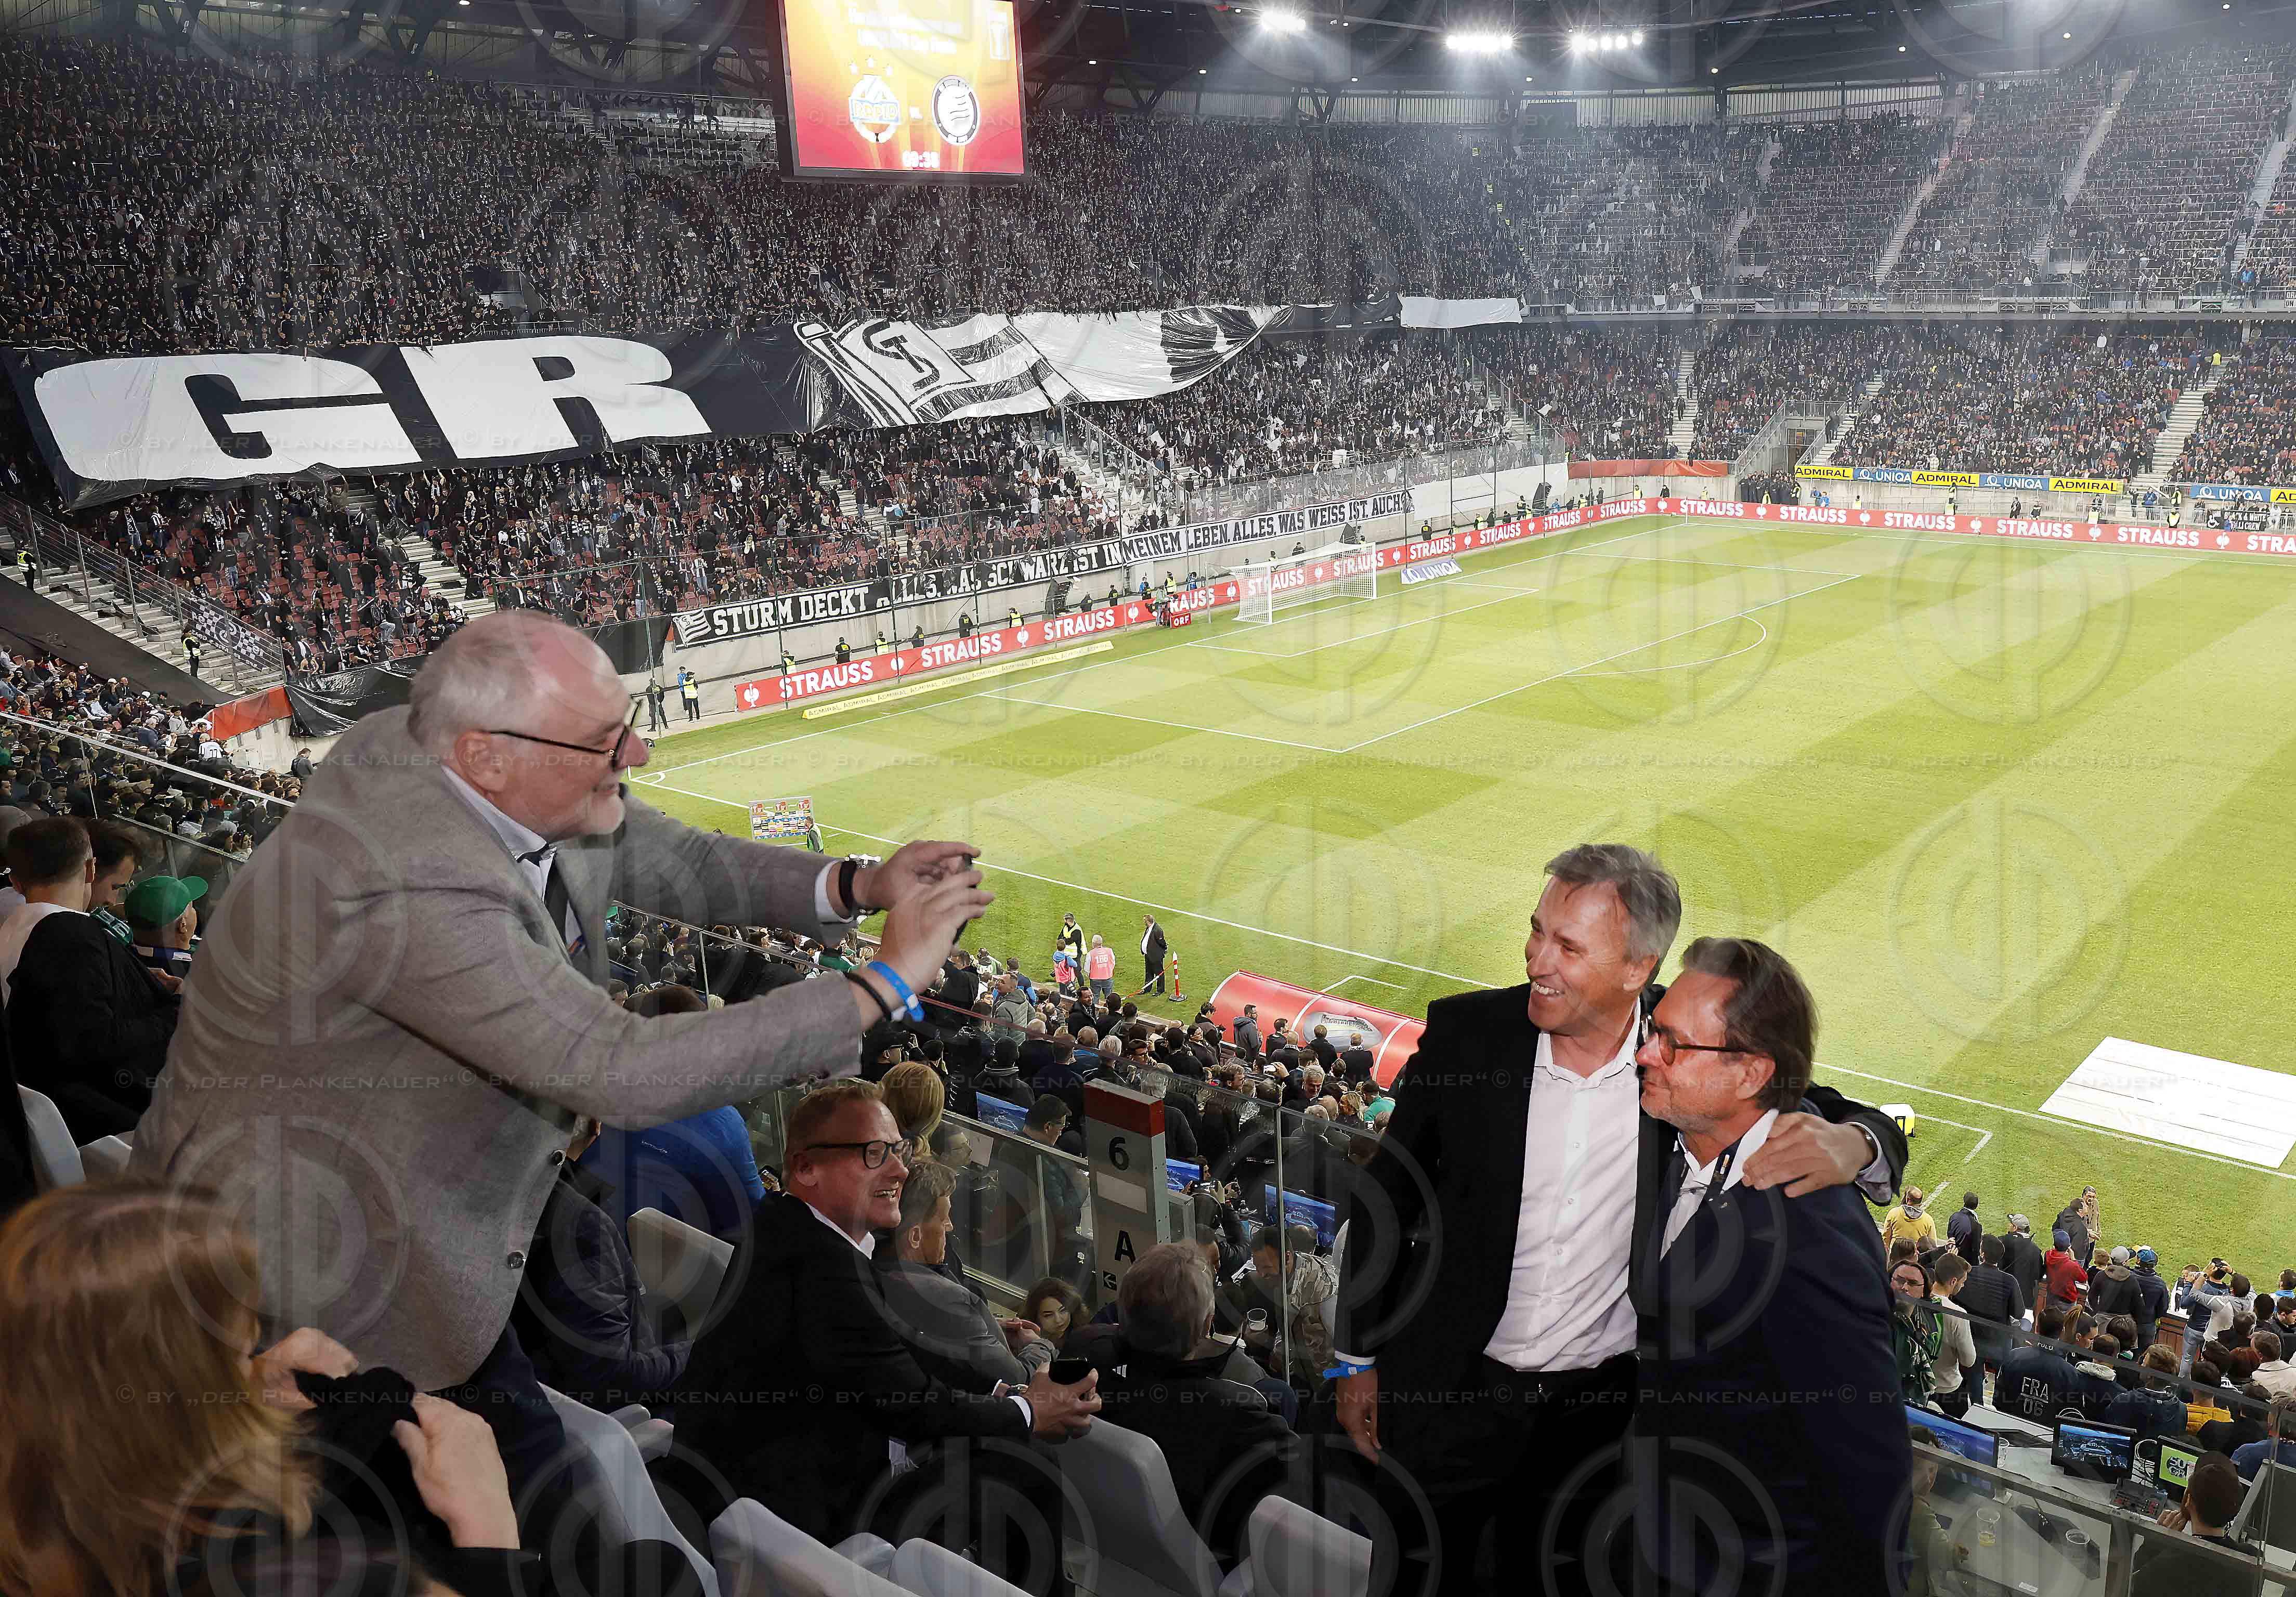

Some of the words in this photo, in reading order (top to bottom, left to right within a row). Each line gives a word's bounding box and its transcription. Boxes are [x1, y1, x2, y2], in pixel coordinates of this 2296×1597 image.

[1795, 467, 1849, 478] ADMIRAL
[1875, 470, 1912, 482] UNIQA
[1916, 473, 1976, 485] ADMIRAL
[2003, 478, 2043, 490] UNIQA
[2053, 480, 2117, 492] ADMIRAL
[2219, 488, 2263, 502] UNQA
[1600, 500, 1646, 518] STRAUSS
[1680, 499, 1744, 517] STRAUSS
[1779, 505, 1847, 524] STRAUSS
[1543, 510, 1581, 531] STRAUSS
[1884, 512, 1956, 530] STRAUSS
[1997, 519, 2073, 539] STRAUSS
[1480, 523, 1521, 545] STRAUSS
[2117, 526, 2200, 546] STRAUSS
[1410, 536, 1456, 560] STRAUSS
[713, 598, 793, 636] STURM
[799, 586, 869, 620] DECKT
[1103, 542, 1123, 567] IN
[1121, 531, 1182, 561] MEINEM
[1186, 524, 1230, 549] LEBEN.
[1278, 512, 1304, 533] WAS
[1308, 504, 1346, 528] WEISS
[1424, 559, 1463, 580] UNIQA
[1043, 609, 1115, 641] STRAUSS
[1173, 615, 1190, 627] ORF
[921, 633, 1002, 669] STRAUSS
[779, 660, 873, 698] STRAUSS
[1109, 1136, 1130, 1171] 6
[1115, 1230, 1136, 1265] A
[2021, 1377, 2049, 1400] FRA
[2024, 1398, 2043, 1416] 06
